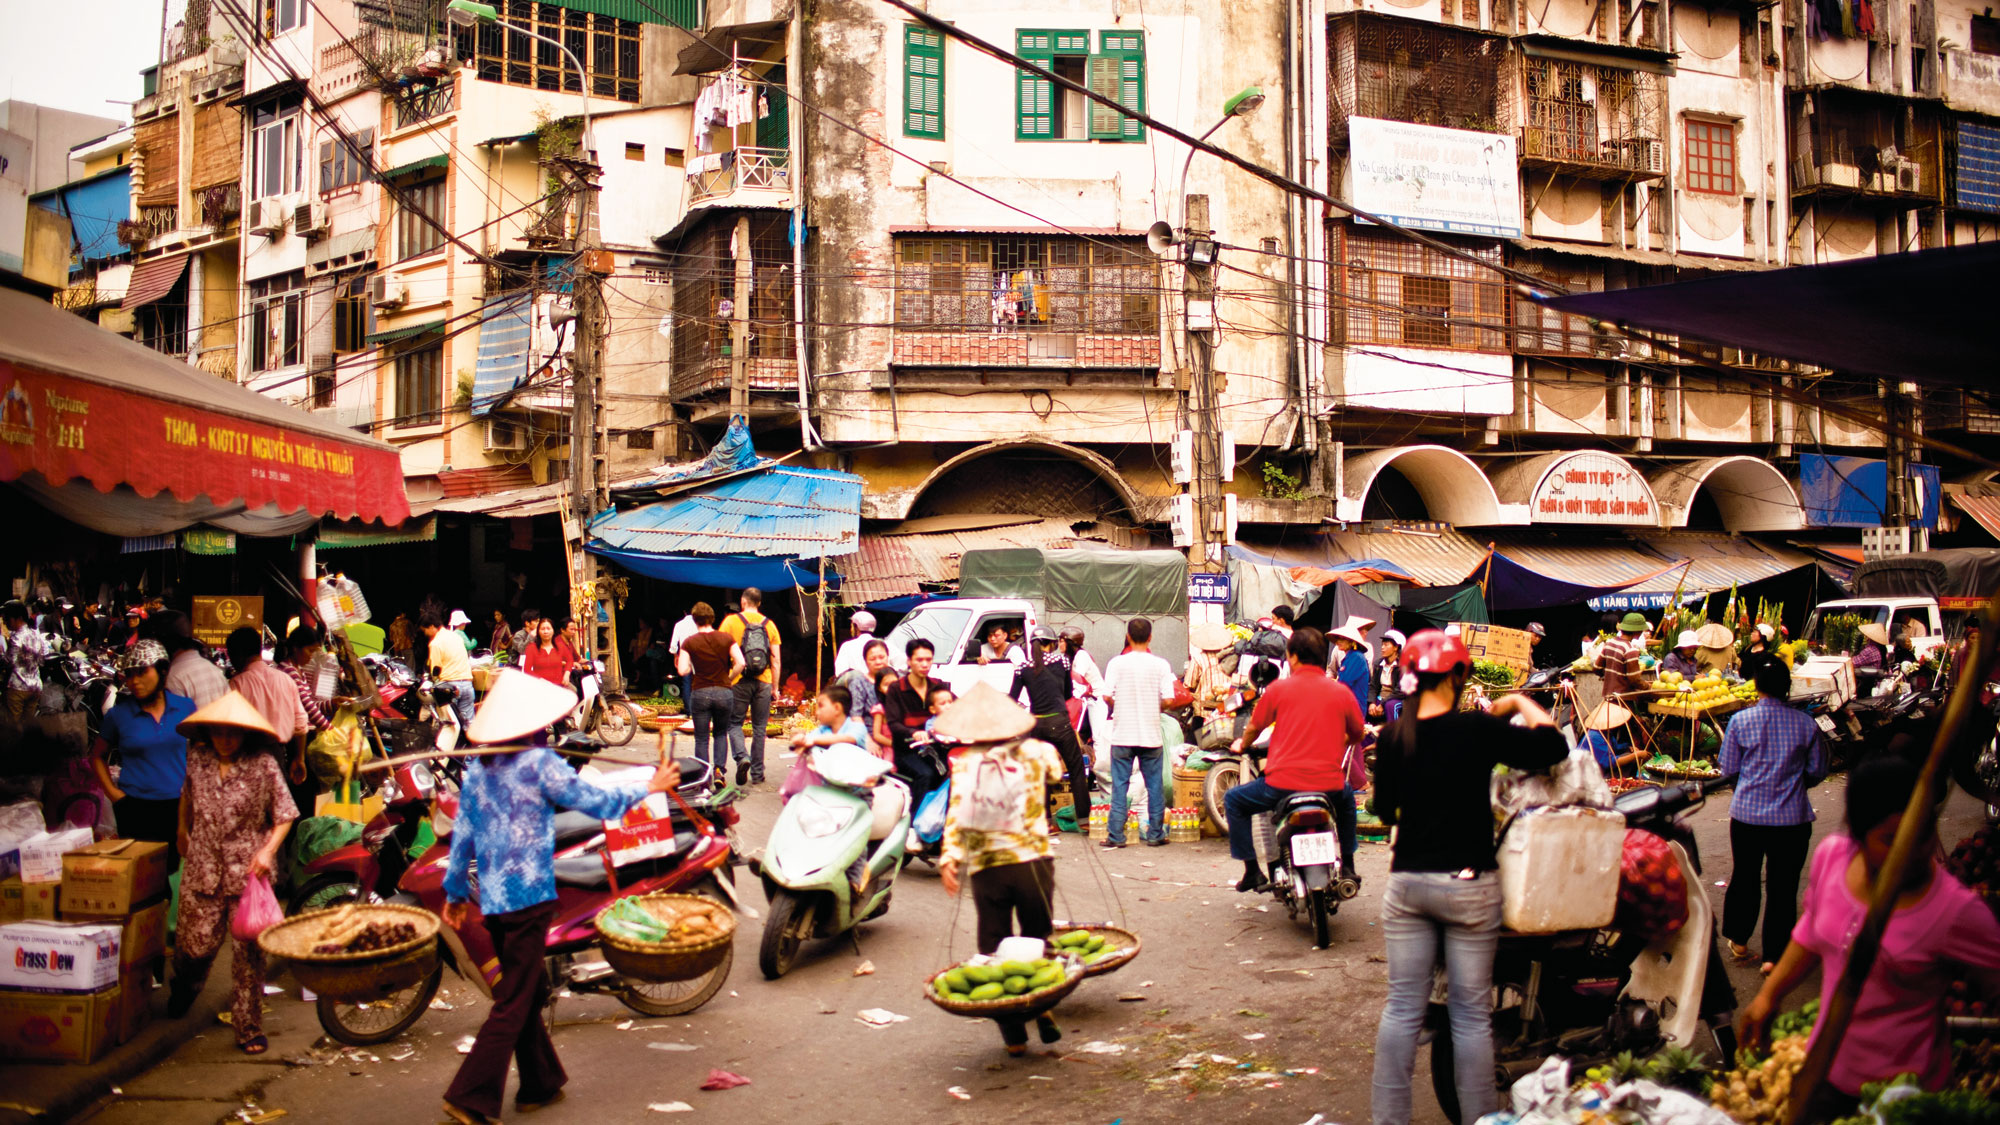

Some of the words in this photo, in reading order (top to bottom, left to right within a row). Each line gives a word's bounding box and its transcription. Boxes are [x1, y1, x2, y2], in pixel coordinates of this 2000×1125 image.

[164, 417, 197, 447] THOA
[251, 431, 294, 464] NGUYỄN
[295, 443, 325, 472] THIỆN
[326, 450, 354, 475] THUẬT
[1589, 472, 1598, 484] TY
[1603, 596, 1628, 607] HÀNG
[16, 946, 48, 969] Grass
[50, 950, 74, 970] Dew
